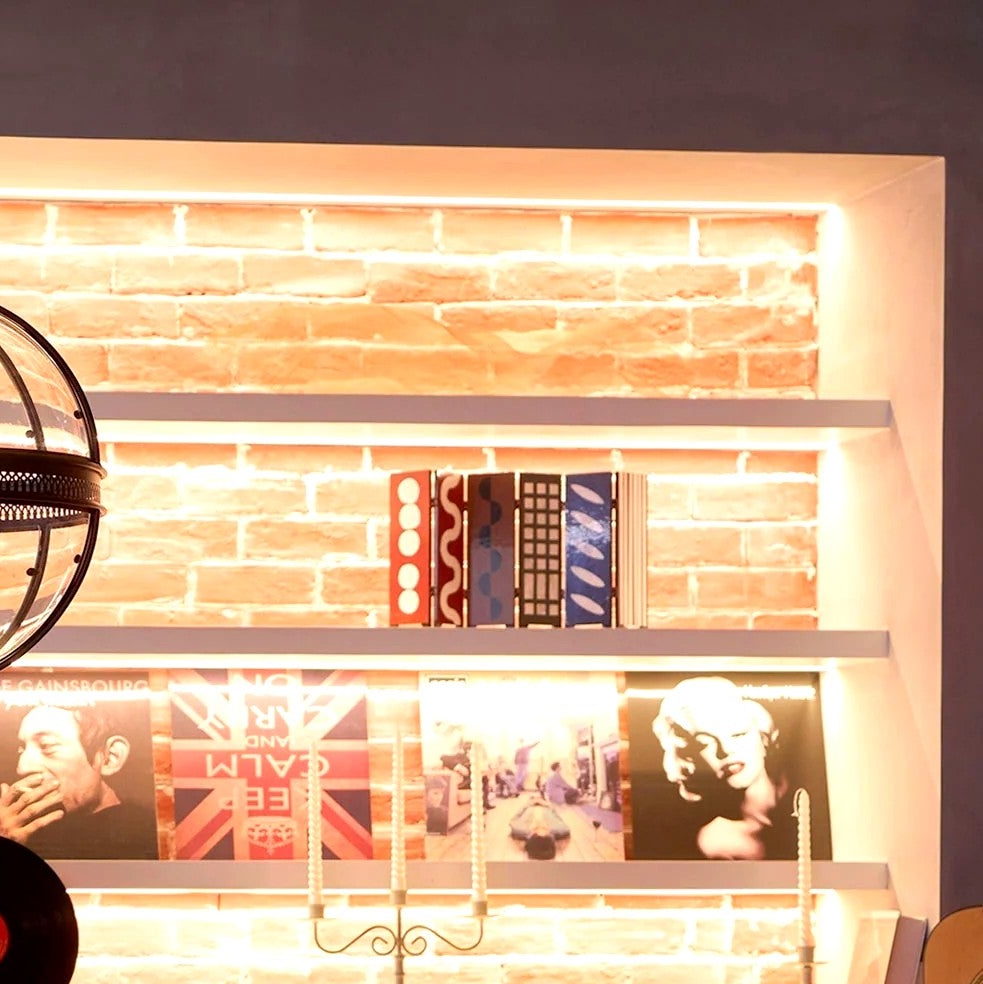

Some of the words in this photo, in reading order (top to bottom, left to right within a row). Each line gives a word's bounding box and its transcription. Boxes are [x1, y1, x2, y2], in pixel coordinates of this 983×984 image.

[197, 705, 338, 729] CARY
[245, 735, 289, 748] AND
[205, 754, 330, 778] CALM
